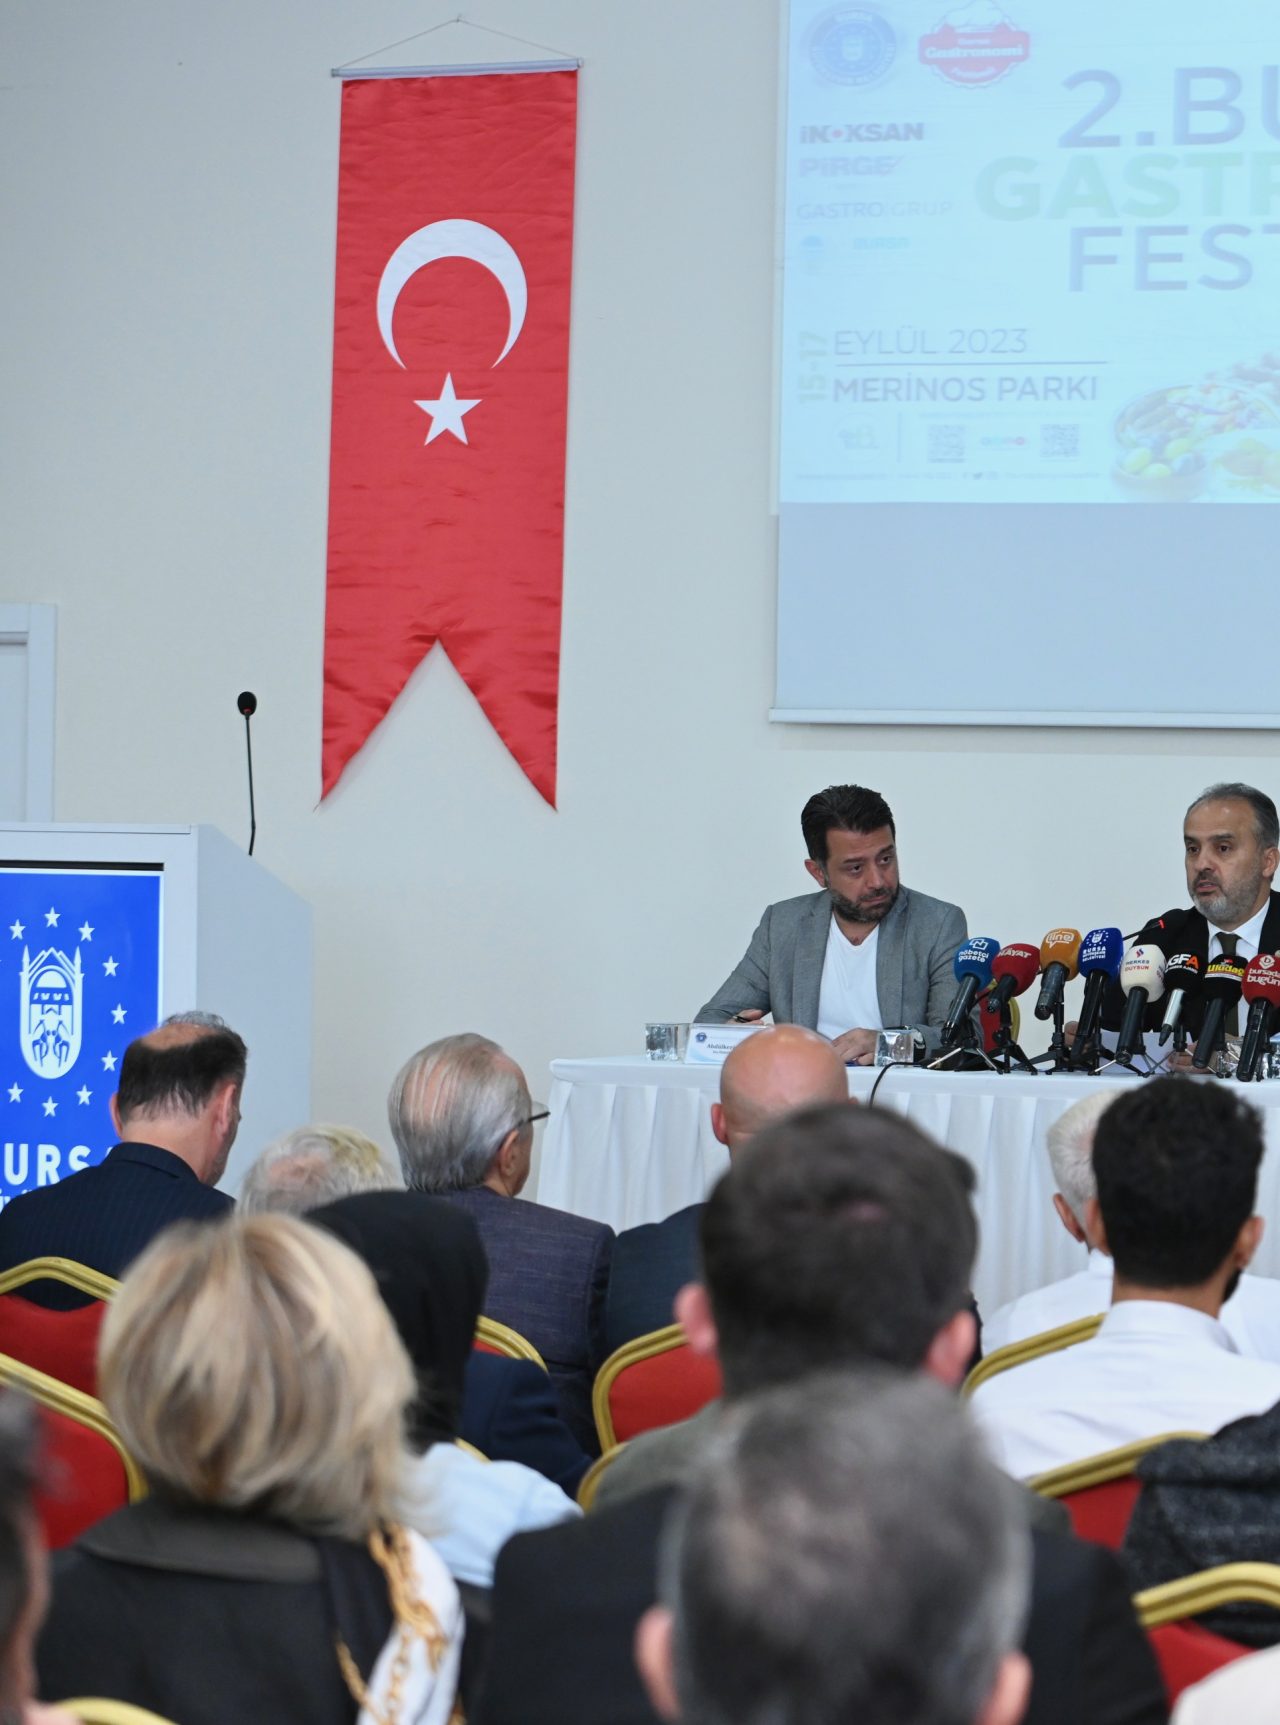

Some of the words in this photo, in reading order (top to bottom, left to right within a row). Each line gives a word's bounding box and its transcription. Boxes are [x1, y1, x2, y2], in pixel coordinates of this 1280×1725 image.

[833, 325, 938, 356] EYLÜL
[947, 328, 1028, 355] 2023
[832, 372, 987, 403] MERİNOS
[997, 376, 1099, 402] PARKI
